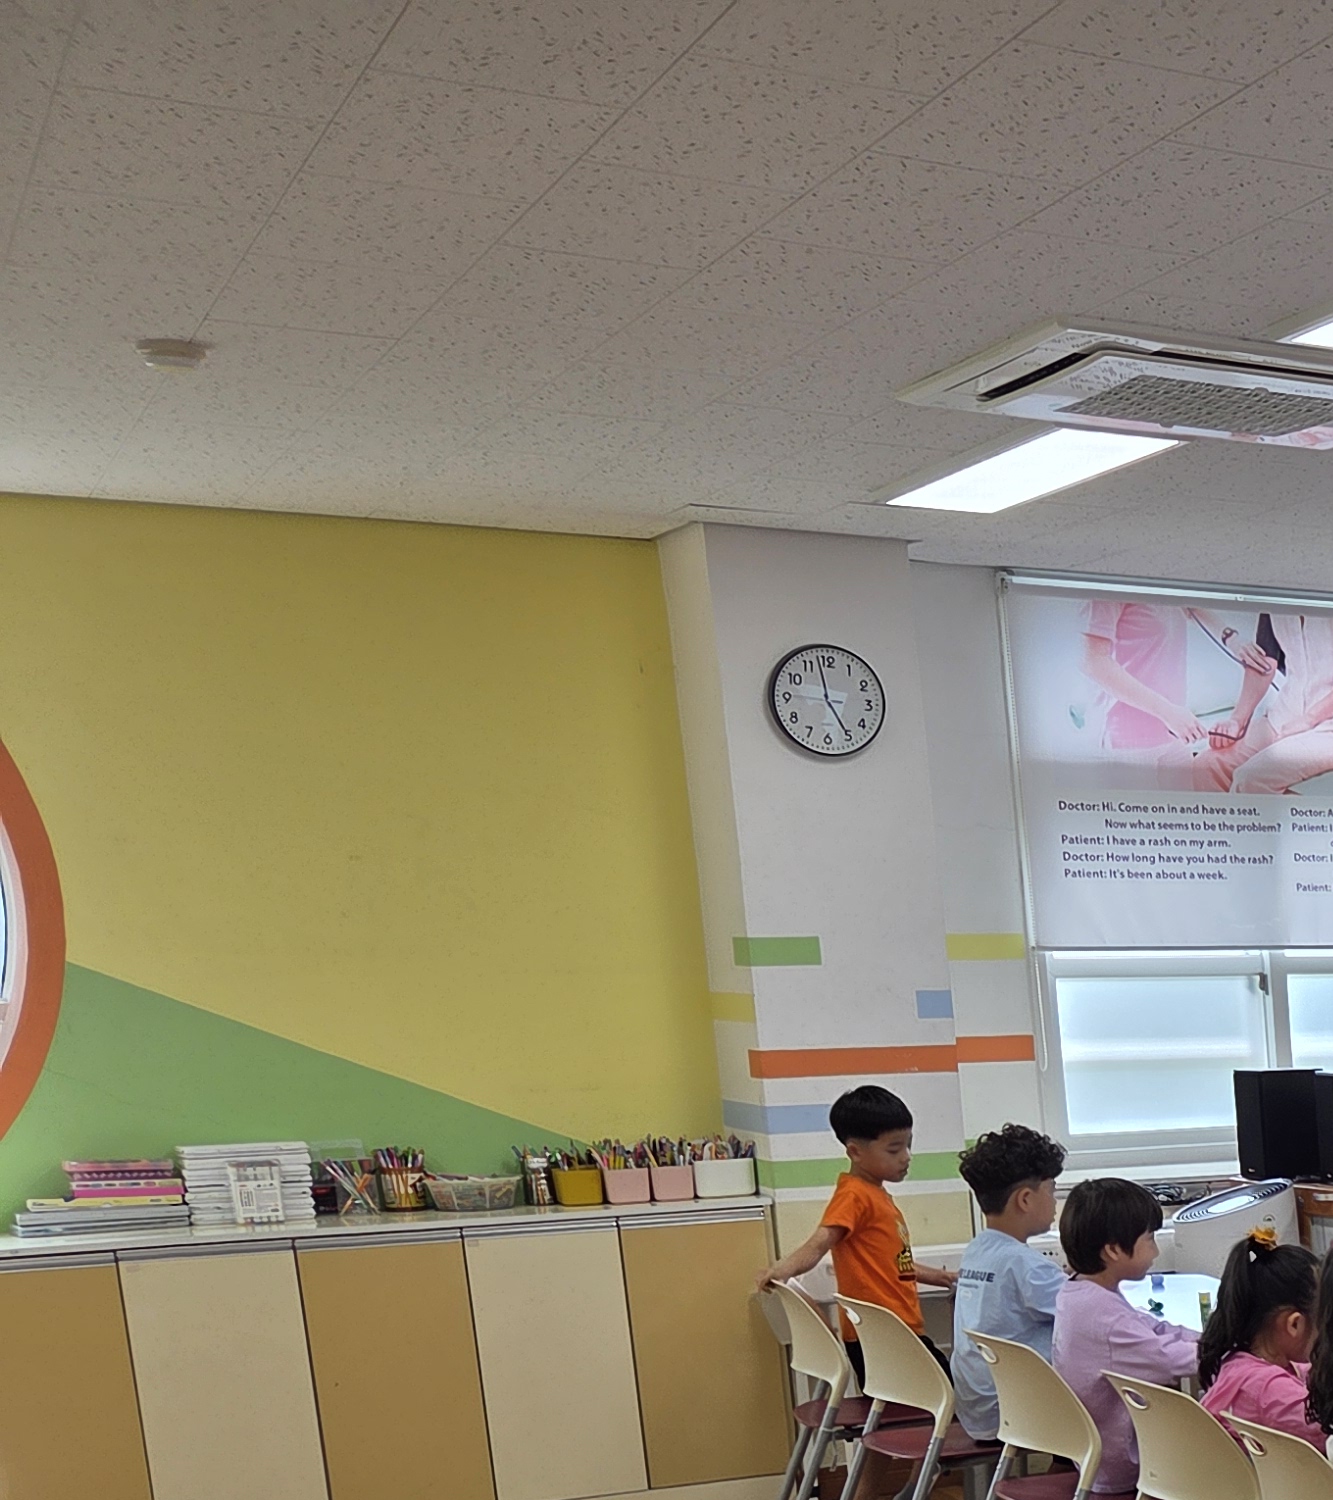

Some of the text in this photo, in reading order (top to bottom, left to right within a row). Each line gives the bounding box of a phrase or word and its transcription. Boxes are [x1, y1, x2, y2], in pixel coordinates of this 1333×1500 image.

[803, 660, 813, 673] 11
[821, 655, 835, 669] 12
[846, 664, 851, 677] 1
[788, 673, 802, 685] 10
[860, 680, 868, 692] 2
[782, 692, 792, 704] 9
[864, 699, 872, 711] 3
[790, 712, 798, 724] 8
[858, 718, 866, 729] 4
[805, 726, 813, 738] 7
[844, 730, 852, 741] 5
[824, 733, 832, 745] 6
[1058, 800, 1100, 812] Doctor:
[1102, 802, 1117, 812] Hi.
[1118, 802, 1148, 813] Come
[1151, 805, 1165, 814] on
[1167, 804, 1178, 813] in
[1179, 805, 1199, 814] and
[1202, 805, 1227, 815] have
[1237, 807, 1260, 816] seat.
[1290, 808, 1326, 817] Doctor:
[1105, 819, 1281, 833] Now what seems to be the problem?
[1292, 823, 1328, 832] Patient:
[1061, 835, 1104, 845] Patient:
[1112, 836, 1137, 846] have
[1148, 837, 1171, 847] rash
[1174, 839, 1187, 847] on
[1189, 839, 1205, 849] my
[1207, 840, 1231, 848] arm.
[1063, 852, 1274, 865] Doctor: How long have you had the rash?
[1294, 853, 1328, 862] Doctor:
[1064, 868, 1107, 878] Patient:
[1109, 869, 1125, 879] It's
[1127, 870, 1152, 879] been
[1155, 870, 1187, 879] about
[1197, 871, 1227, 880] week.
[1296, 883, 1331, 892] Patient:
